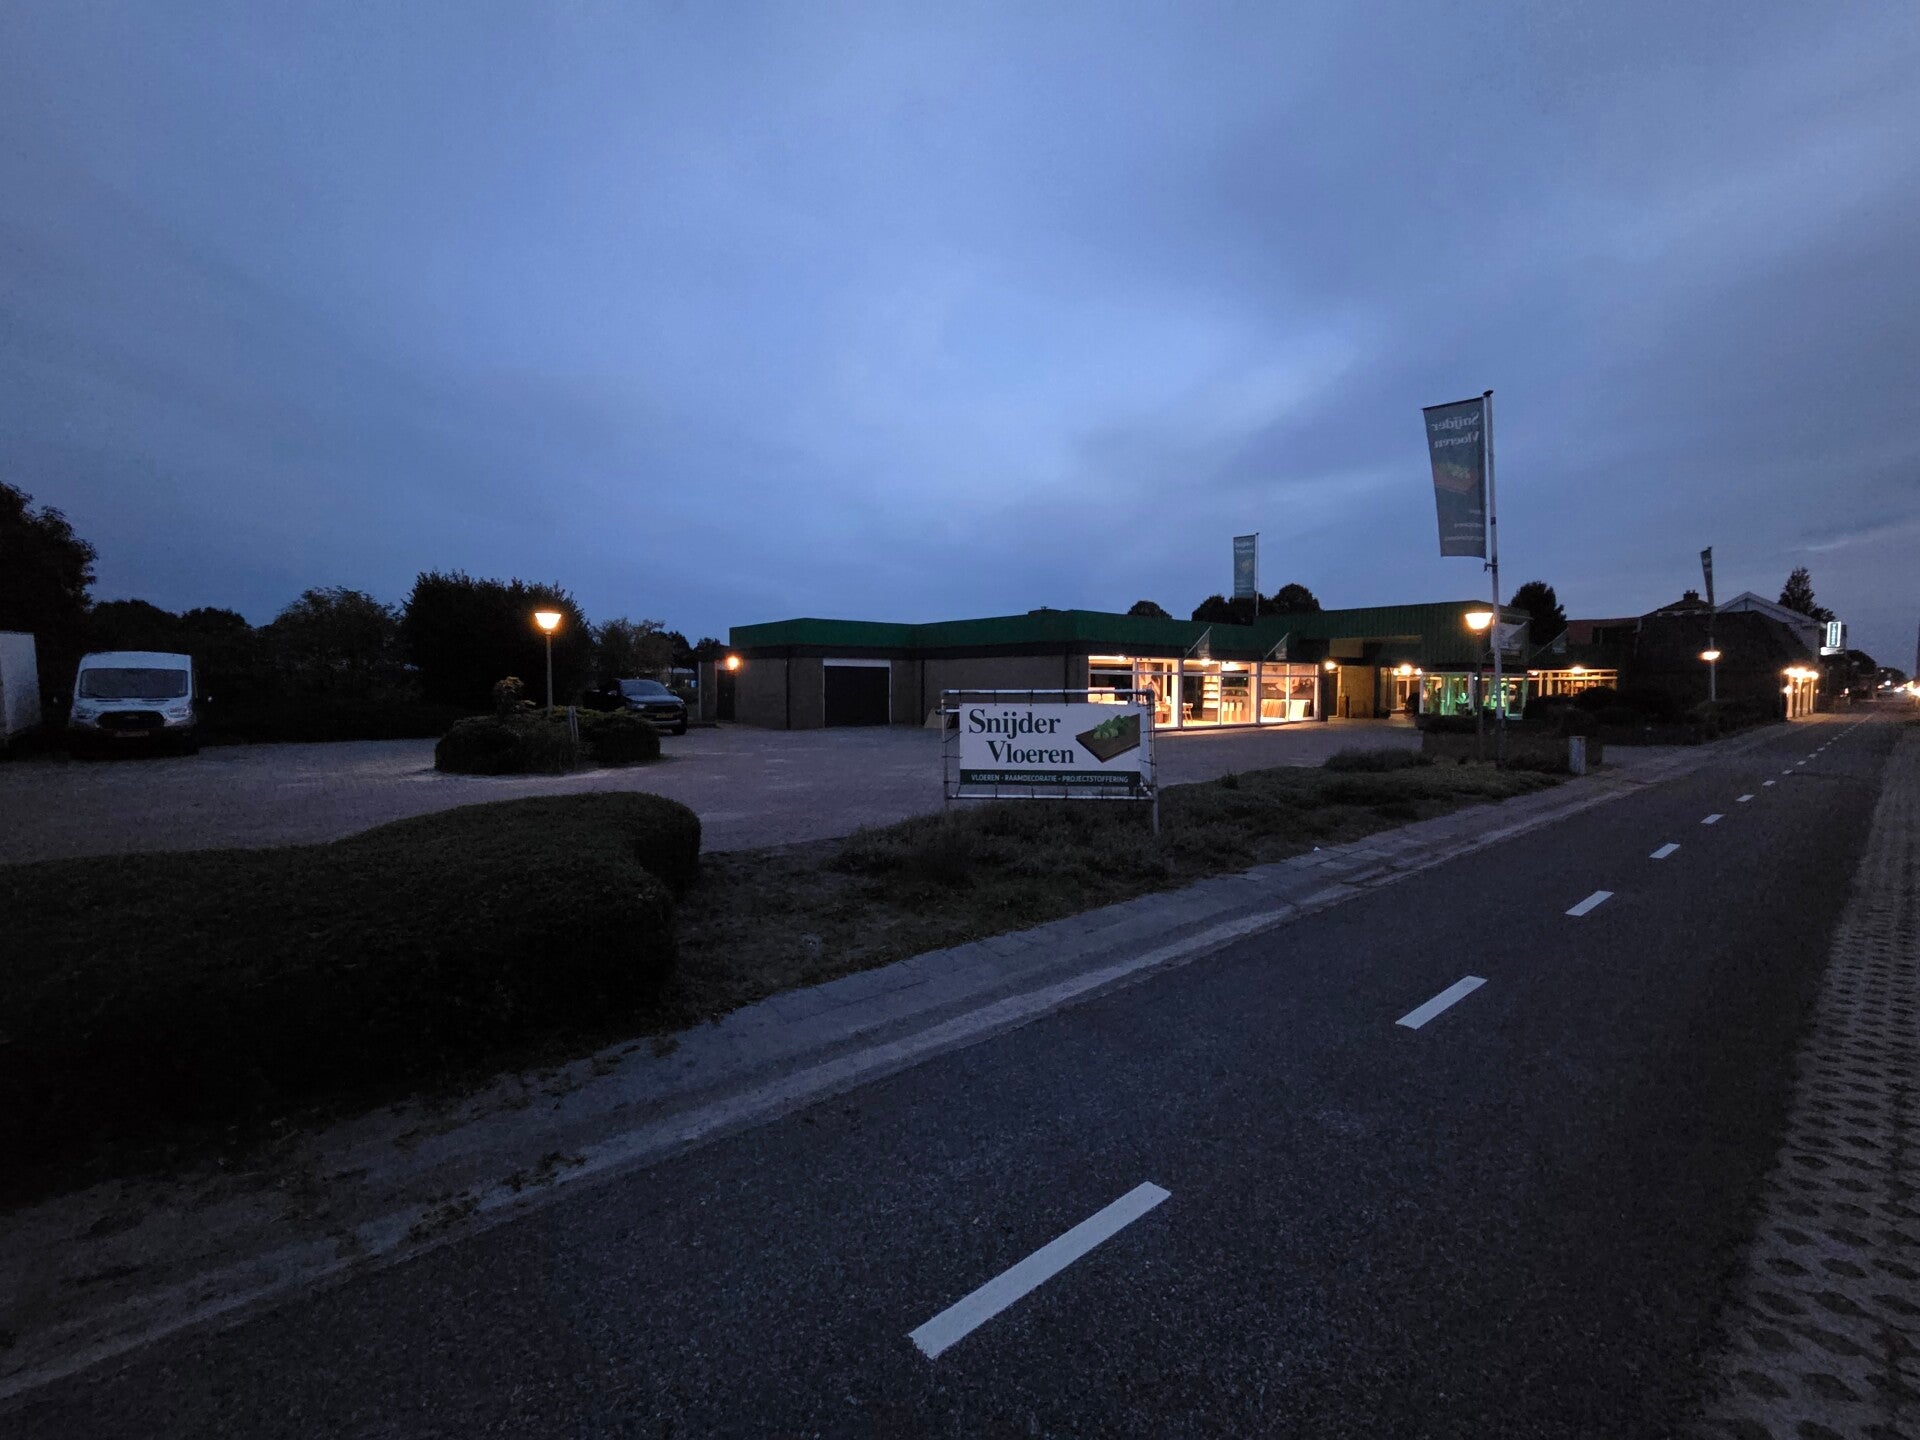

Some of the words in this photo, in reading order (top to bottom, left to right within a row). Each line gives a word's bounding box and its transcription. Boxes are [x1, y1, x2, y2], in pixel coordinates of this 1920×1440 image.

[968, 708, 1061, 739] Snijder
[986, 740, 1075, 764] Vloeren
[1004, 774, 1057, 782] RAAMDECORATIE
[1062, 775, 1129, 783] PROJECTSTOFFERING
